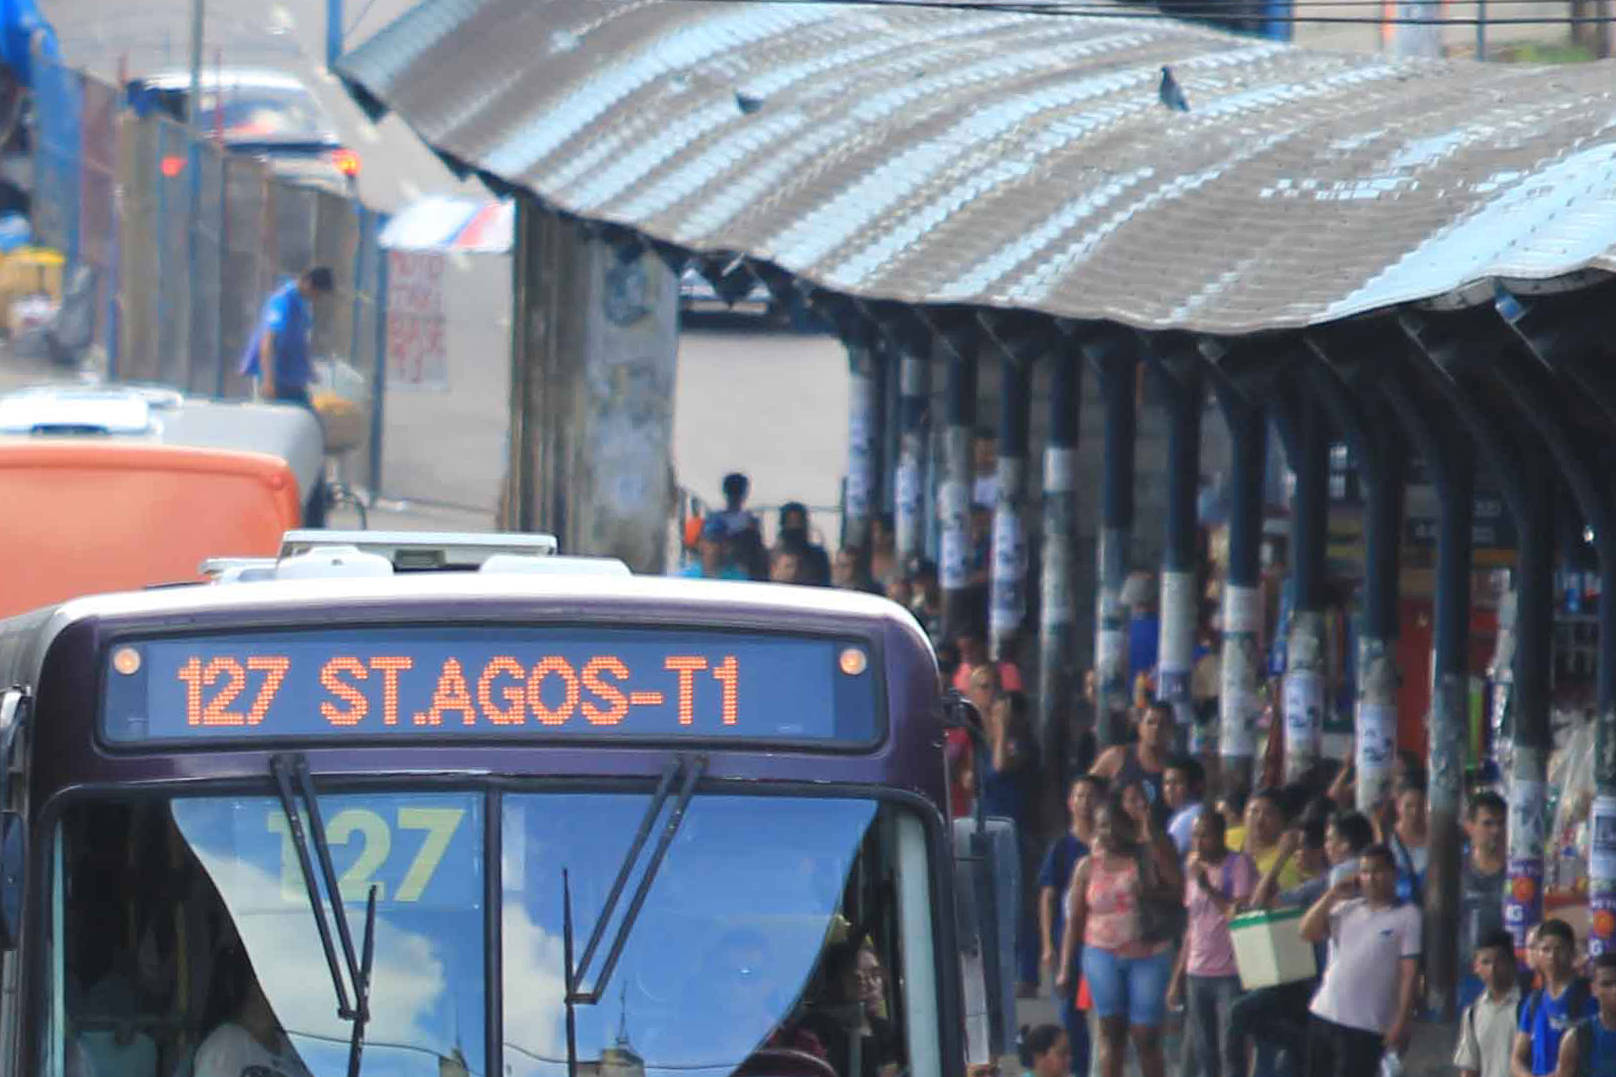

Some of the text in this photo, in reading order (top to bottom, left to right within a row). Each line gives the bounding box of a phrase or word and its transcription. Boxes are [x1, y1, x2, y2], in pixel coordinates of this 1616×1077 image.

[178, 656, 738, 725] 127 ST.AGOS-T1
[268, 808, 467, 902] 127
